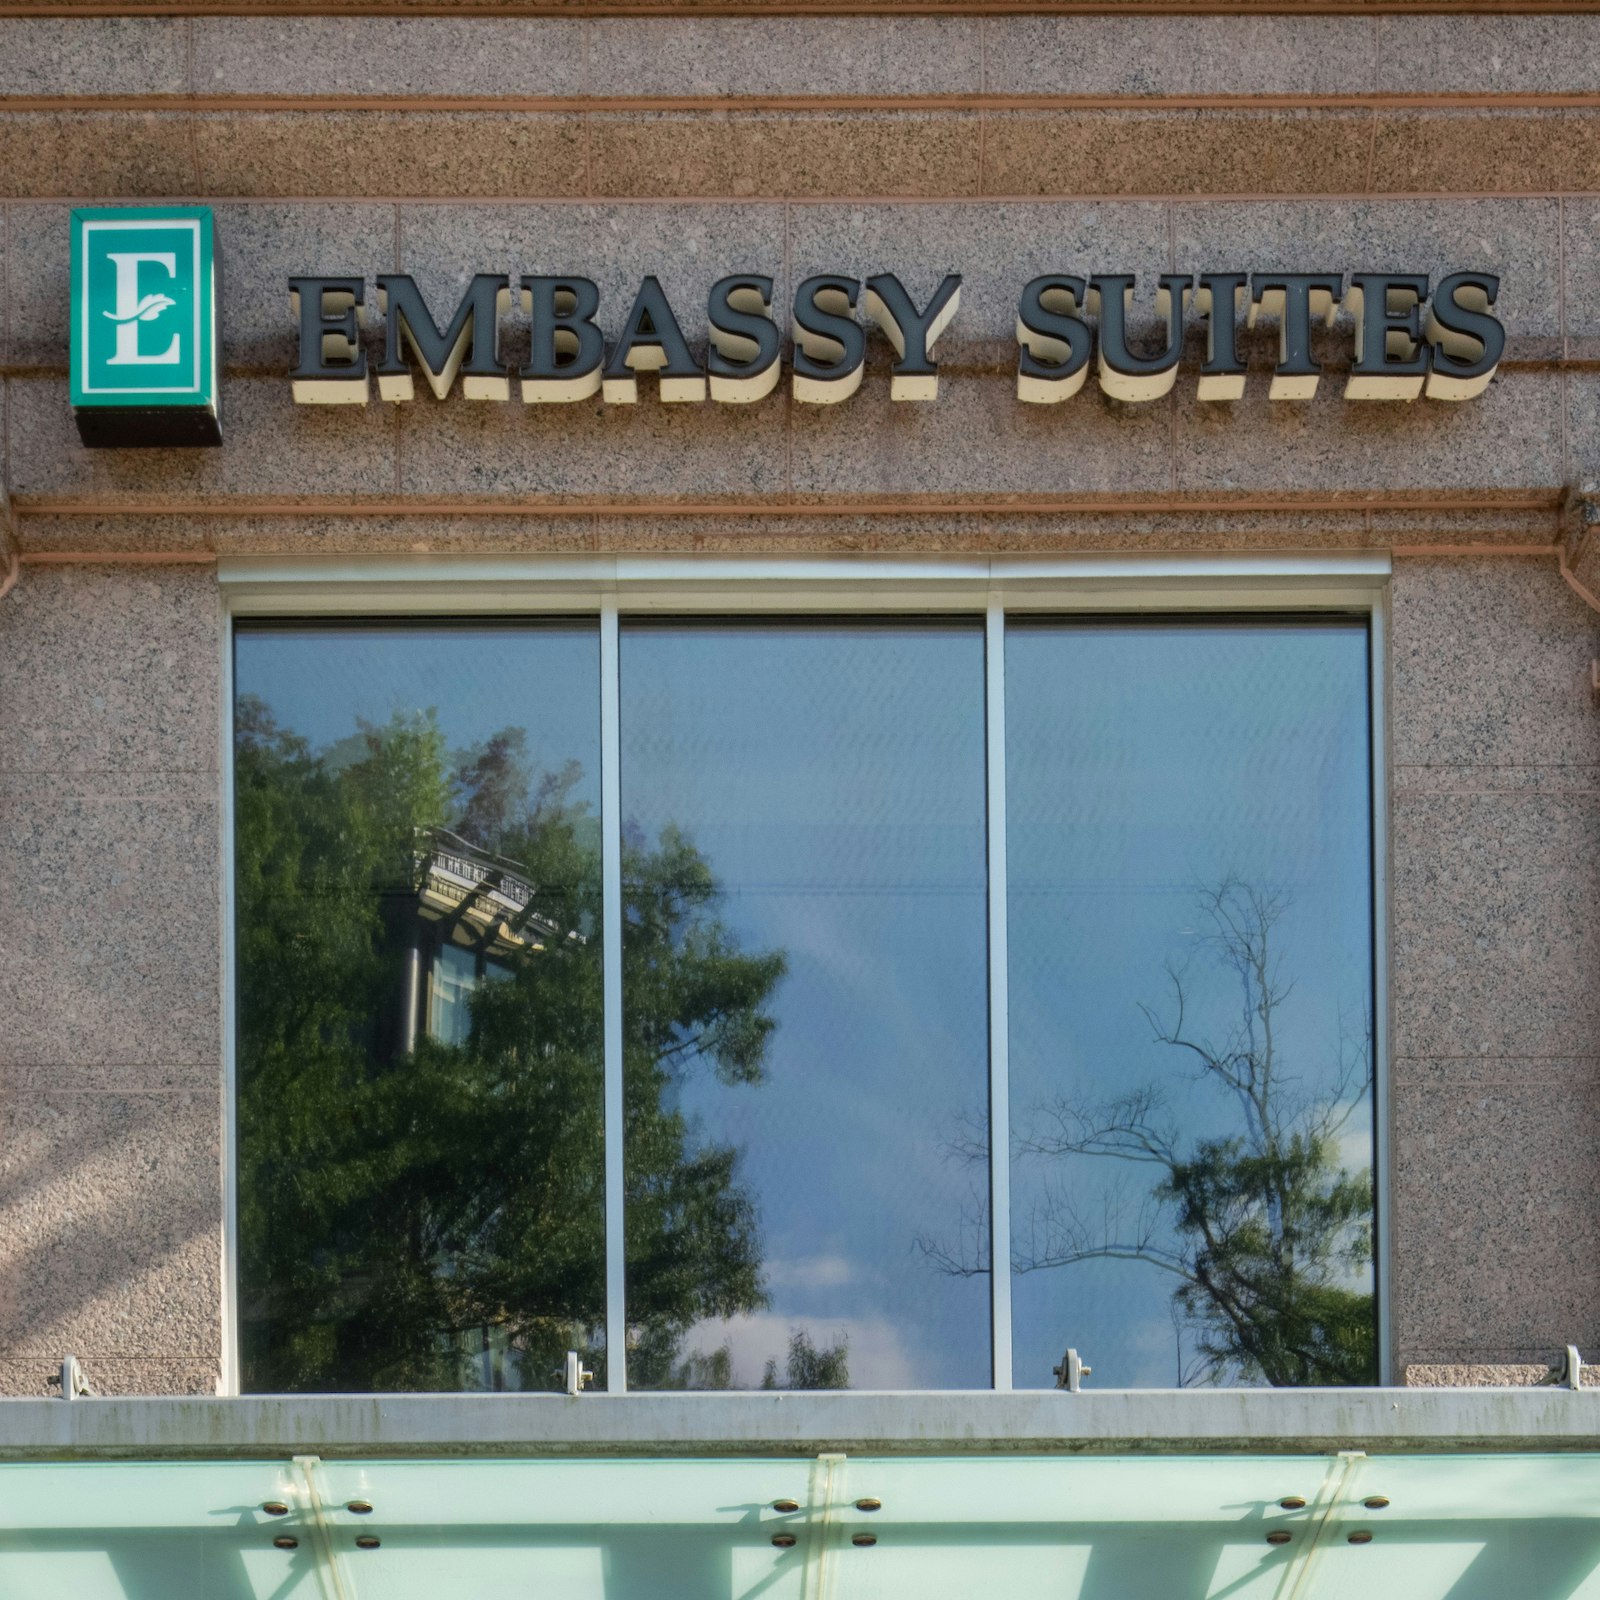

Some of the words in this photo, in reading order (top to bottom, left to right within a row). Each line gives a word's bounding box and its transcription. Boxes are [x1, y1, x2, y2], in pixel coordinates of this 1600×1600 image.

[105, 252, 181, 365] E
[288, 273, 962, 381] EMBASSY
[1018, 271, 1506, 382] SUITES
